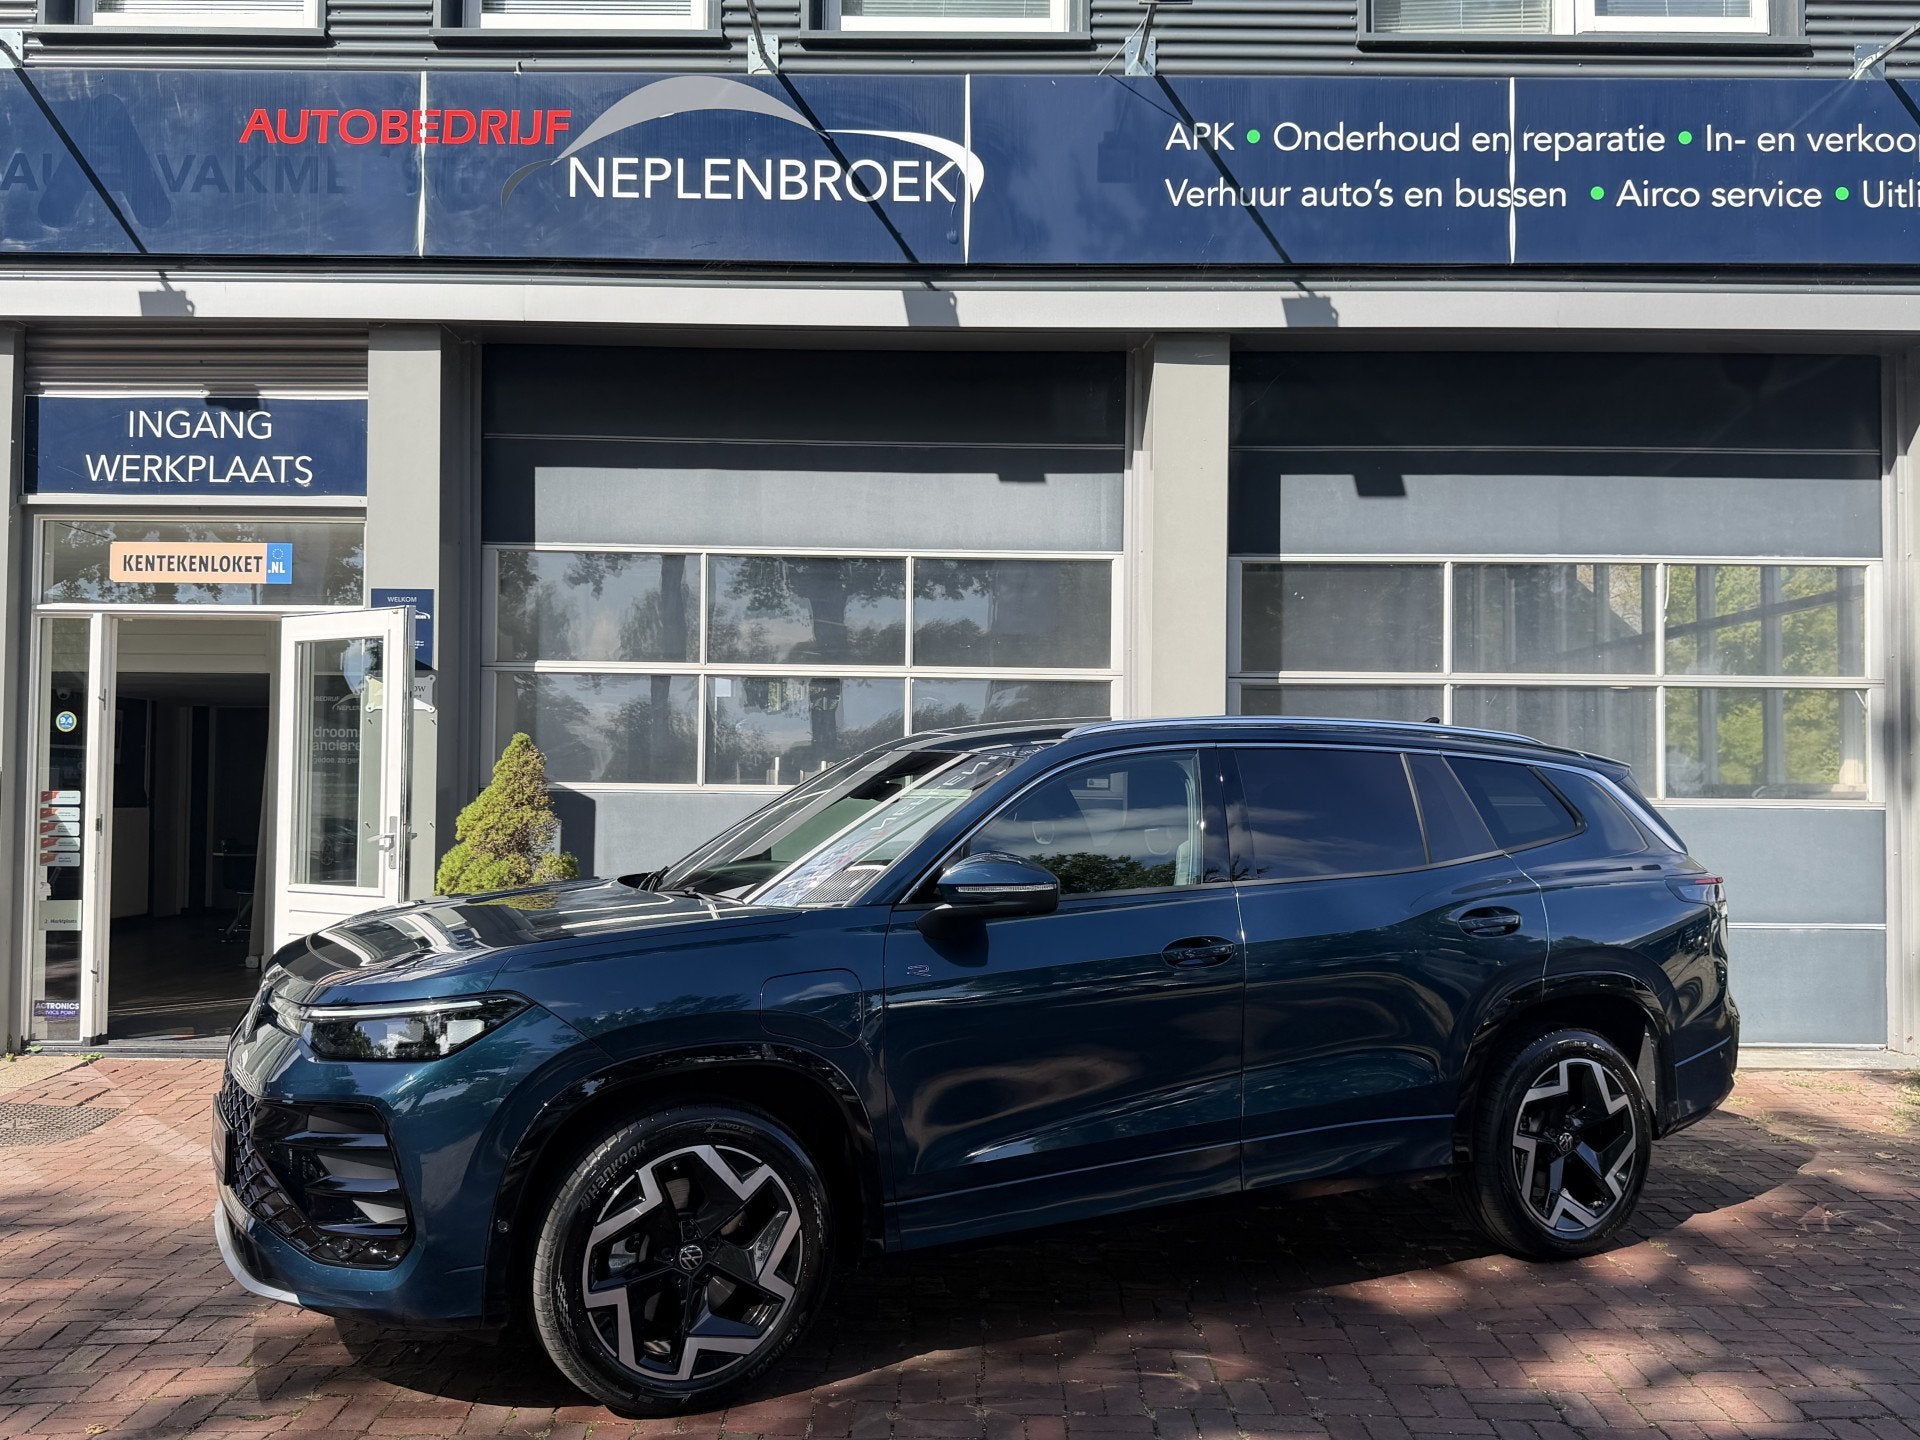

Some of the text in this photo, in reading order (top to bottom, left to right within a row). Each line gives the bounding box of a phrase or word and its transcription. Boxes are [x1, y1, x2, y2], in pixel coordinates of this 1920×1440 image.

[239, 108, 572, 146] AUTOBEDRIJF
[1165, 121, 1920, 162] APK Onderhoud en reparatie In- en verkoo
[568, 156, 957, 203] NEPLENBROEK
[1165, 177, 1292, 207] Verhuur
[1301, 178, 1394, 207] auto's
[1404, 186, 1443, 207] en
[1455, 178, 1568, 208] bussen
[1616, 179, 1701, 208] Airco
[1711, 180, 1822, 208] service
[128, 409, 273, 440] INGANG
[85, 454, 313, 485] WERKPLAATS
[122, 554, 286, 574] KENTEKENLOKET .NL
[313, 726, 360, 738] droom
[35, 1002, 80, 1010] ACTRONICS
